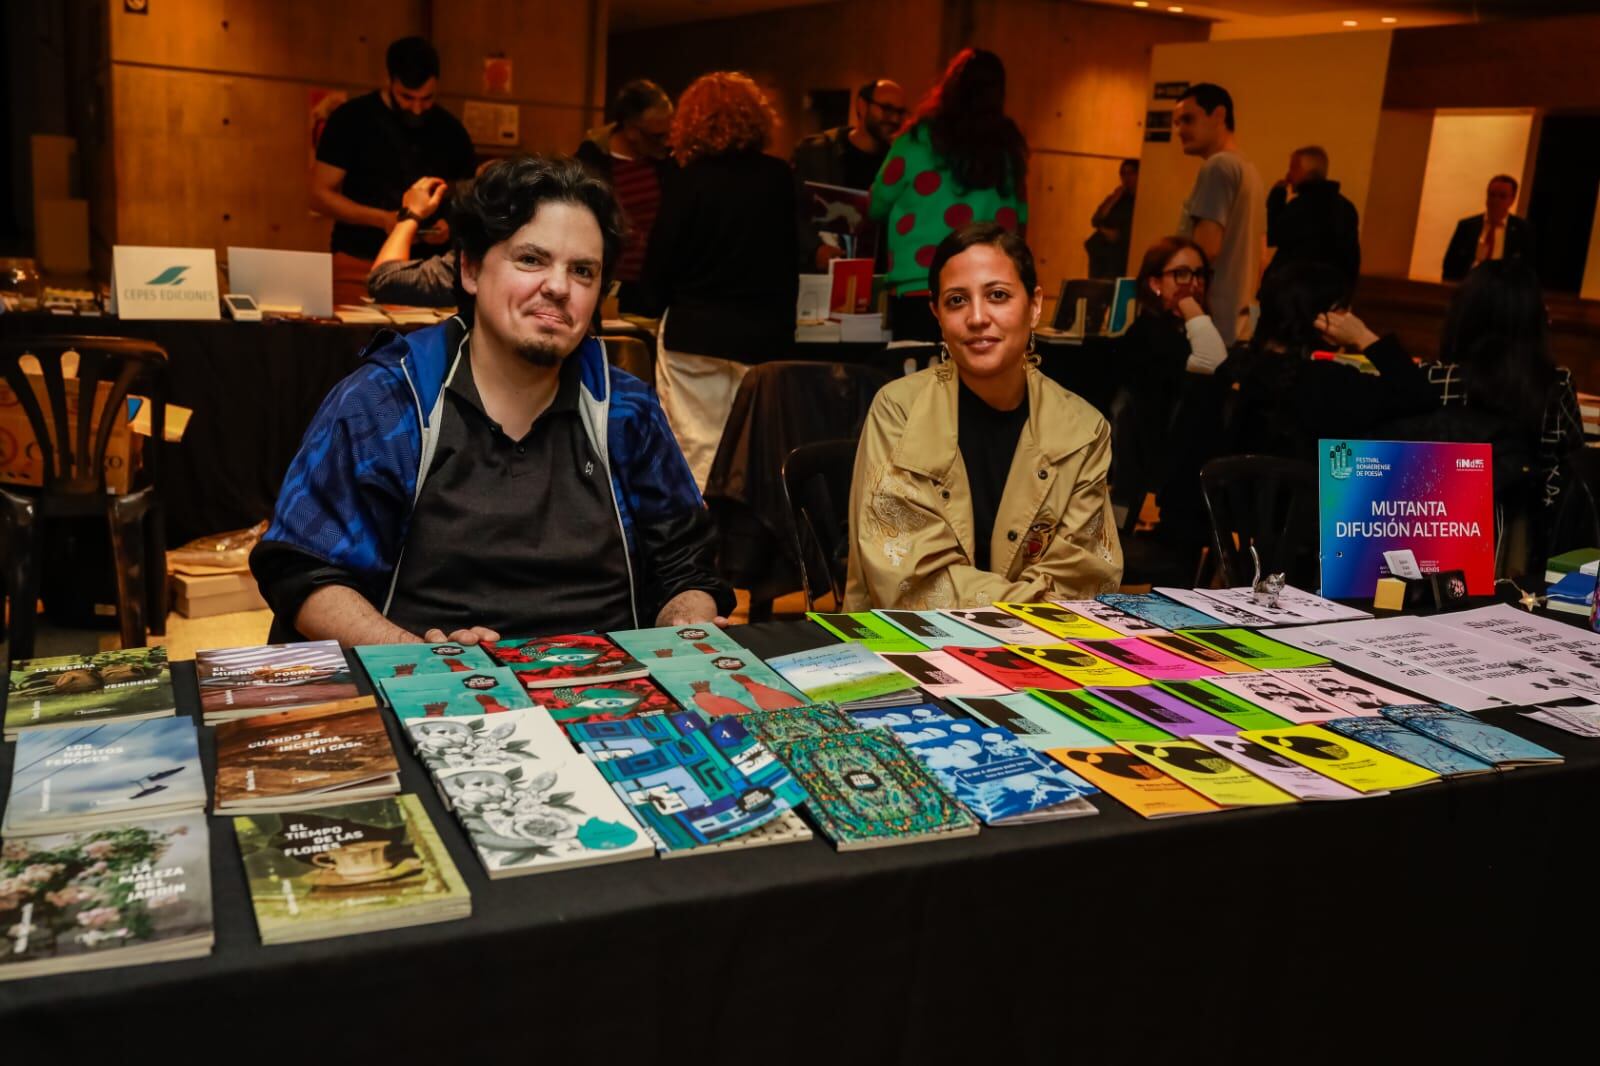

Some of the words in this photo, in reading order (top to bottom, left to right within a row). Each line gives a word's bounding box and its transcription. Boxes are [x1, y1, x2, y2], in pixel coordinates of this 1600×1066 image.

[123, 288, 157, 300] CEPES
[159, 289, 216, 301] EDICIONES
[1371, 500, 1447, 517] MUTANTA
[1336, 518, 1410, 538] DIFUSIÓN
[1413, 521, 1481, 537] ALTERNA
[66, 743, 92, 751] LOS
[248, 734, 301, 749] CUANDO
[304, 730, 321, 738] SE
[279, 735, 341, 752] INCENDIA
[308, 746, 326, 755] MI
[328, 741, 363, 752] CASA
[284, 826, 343, 841] TIEMPO
[289, 823, 308, 832] EL
[313, 835, 333, 845] DE
[336, 830, 364, 842] LAS
[283, 841, 343, 857] FLORES
[118, 866, 185, 885] MALEZA
[131, 863, 153, 875] LA
[134, 879, 168, 892] DEL
